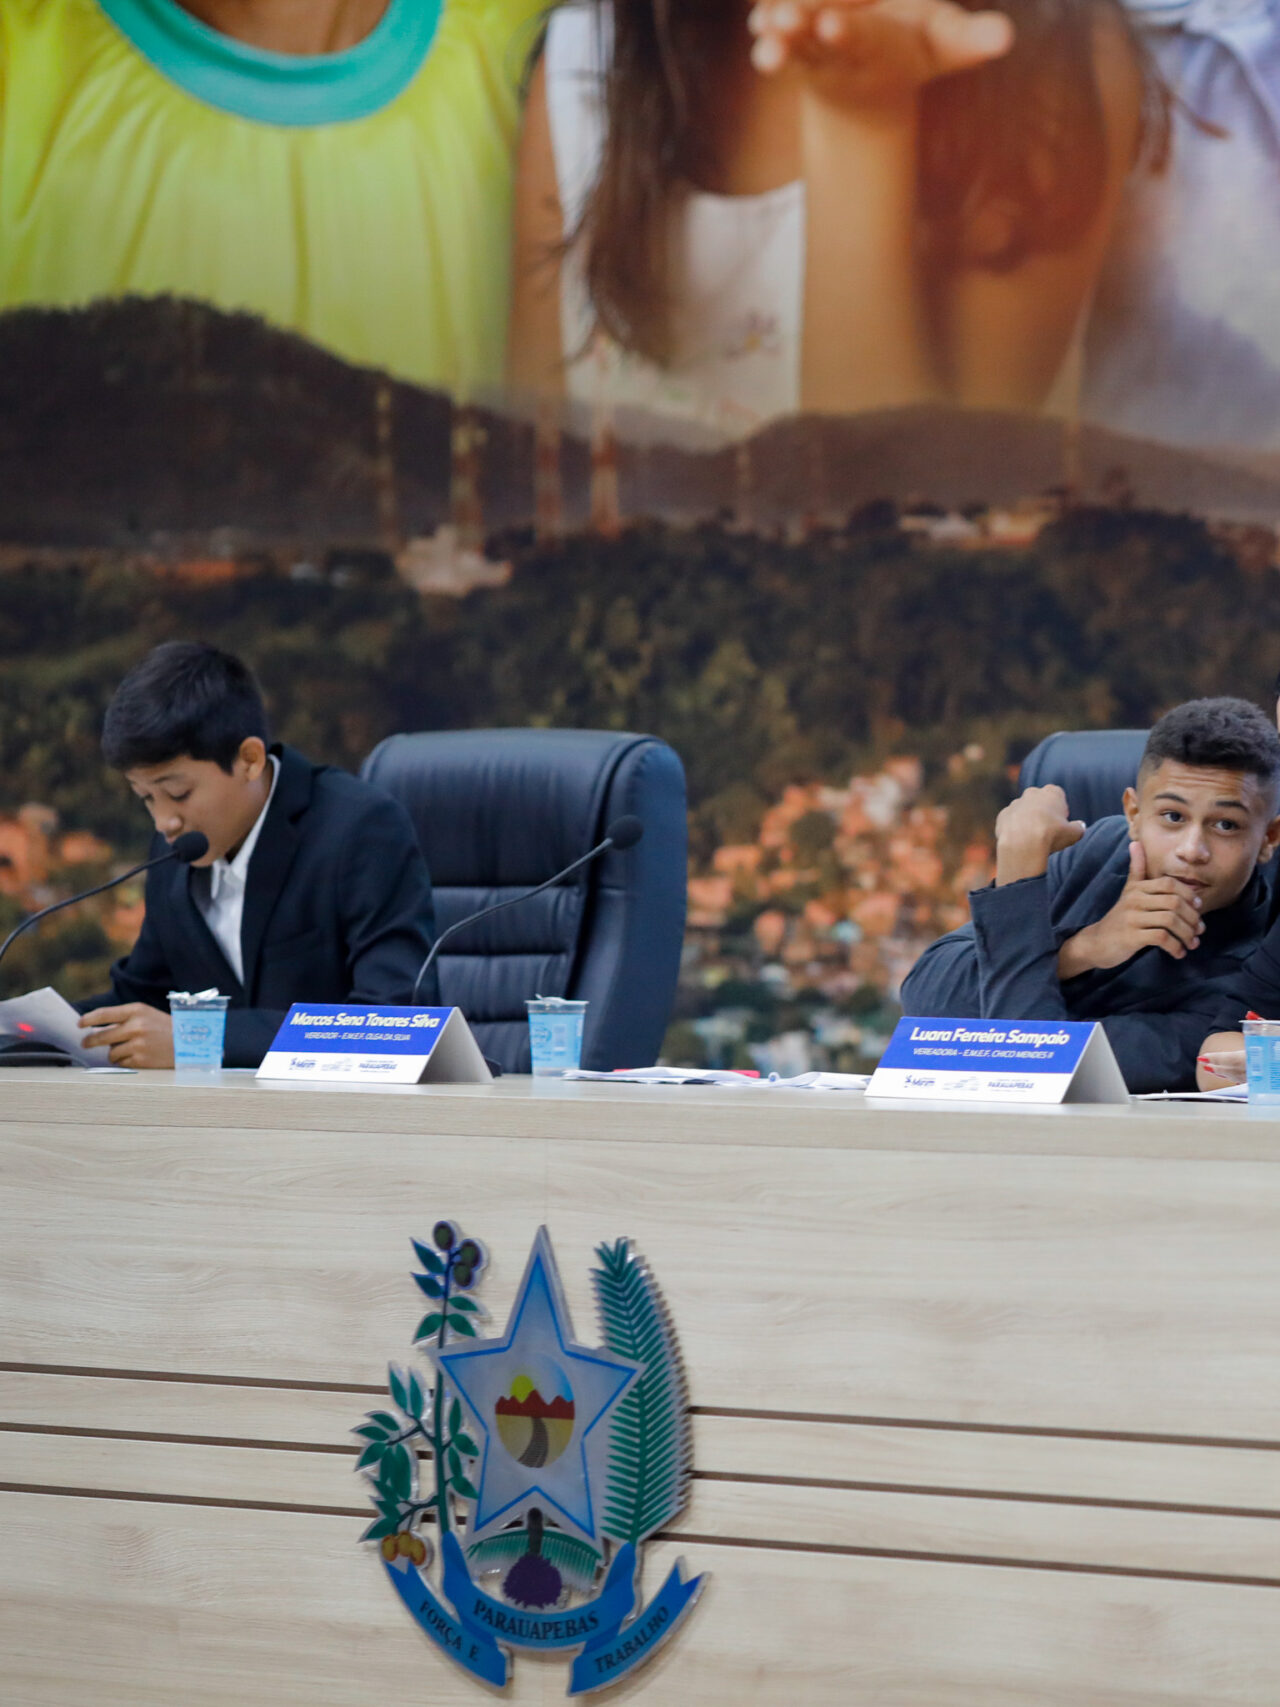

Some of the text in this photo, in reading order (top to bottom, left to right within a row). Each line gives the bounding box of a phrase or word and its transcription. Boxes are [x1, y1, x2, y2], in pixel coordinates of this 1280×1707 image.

[290, 1012, 441, 1029] Marcos Sena Tavares Silva
[910, 1027, 1070, 1049] Luara Ferreira Sampaio
[913, 1047, 958, 1057] VEREADORA
[991, 1050, 1016, 1059] CHICO
[1016, 1051, 1048, 1060] MENDES
[419, 1600, 480, 1663] FORÇA E
[473, 1598, 599, 1641] PARAUAPEBAS
[594, 1605, 670, 1673] TRABALHO
